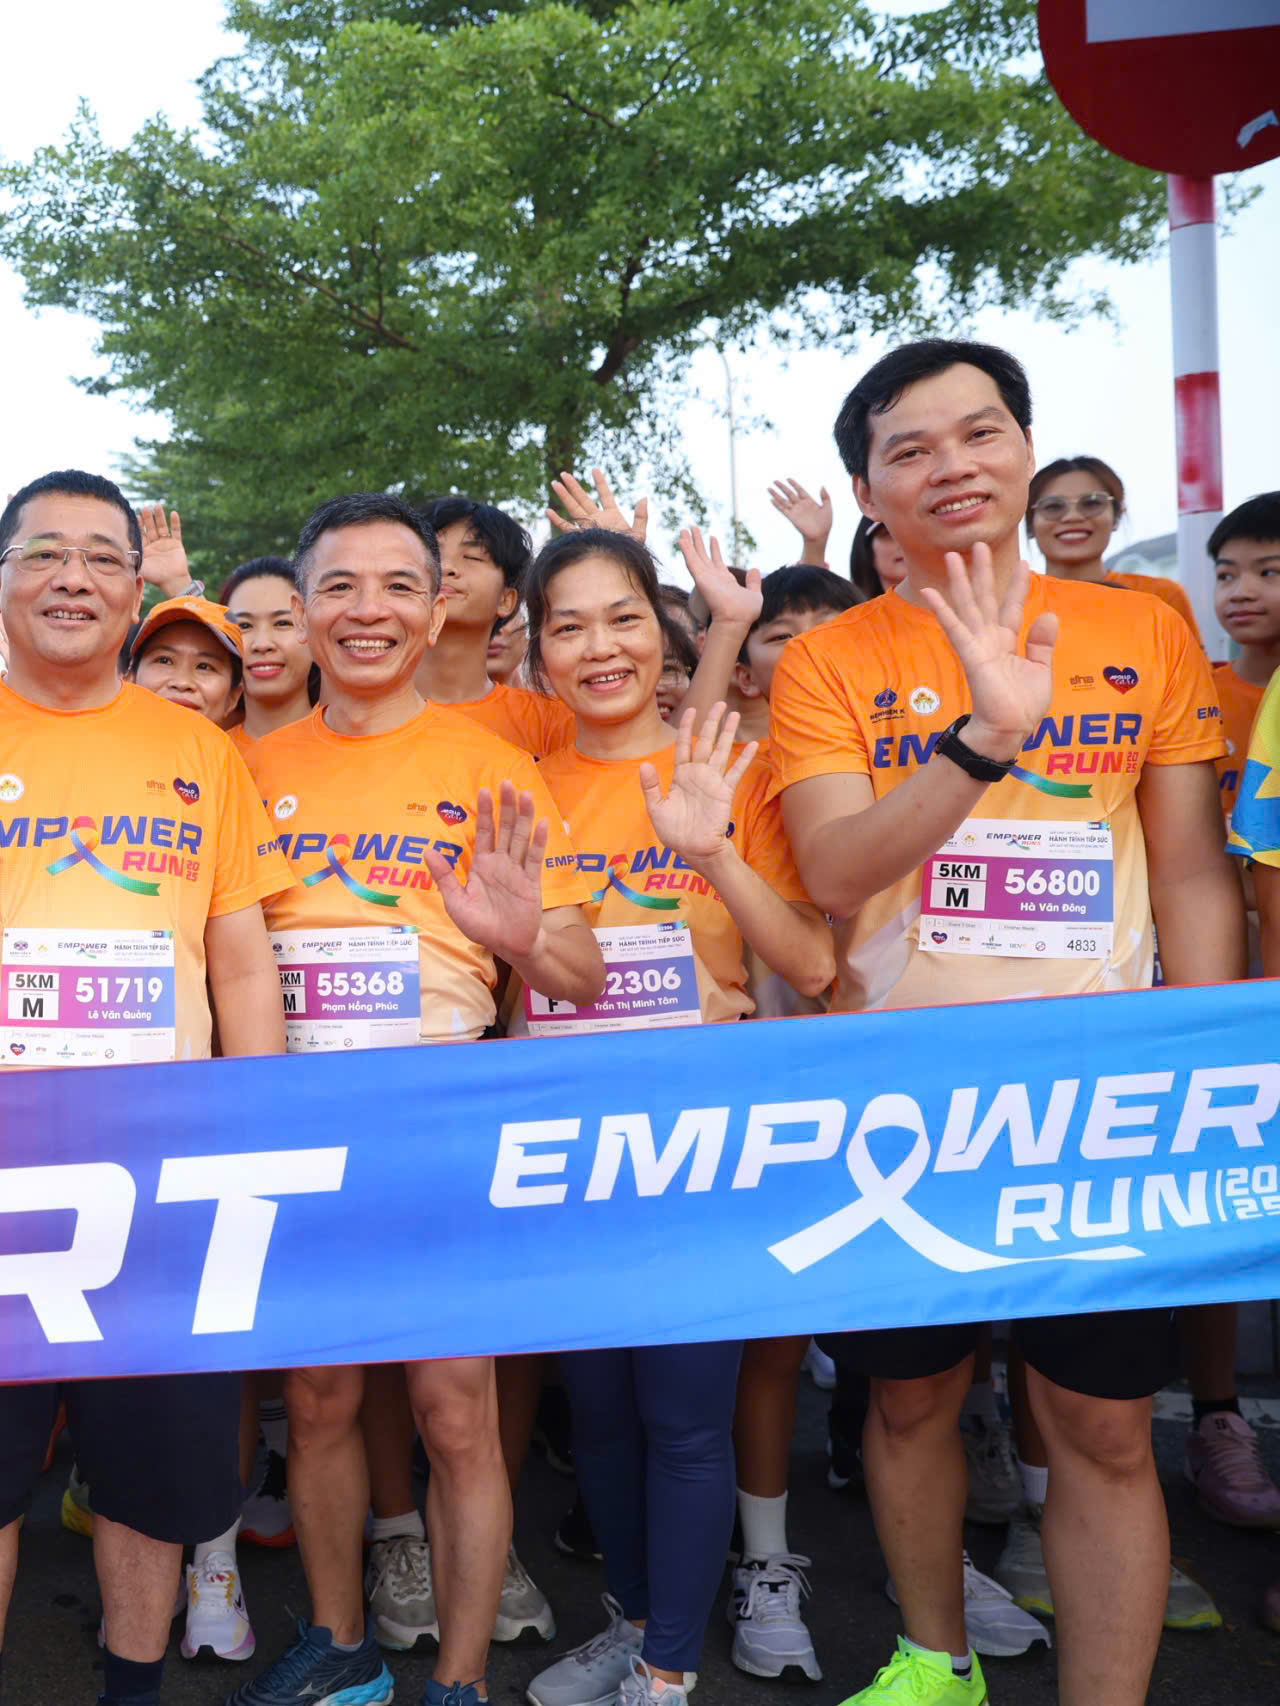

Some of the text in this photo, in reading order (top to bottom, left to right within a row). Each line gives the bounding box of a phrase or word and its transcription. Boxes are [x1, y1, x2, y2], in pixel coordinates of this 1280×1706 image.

[873, 713, 1142, 768] EMWER
[1046, 752, 1122, 775] RUN
[986, 832, 1042, 841] EMPOWER
[122, 851, 184, 877] RUN
[938, 863, 981, 879] 5KM
[366, 865, 433, 890] RUN
[644, 873, 710, 896] RUN
[1004, 868, 1100, 896] 56800
[945, 887, 969, 908] M
[1020, 902, 1036, 912] Hà
[1039, 902, 1059, 913] Văn
[58, 942, 107, 950] EMPOWER
[302, 941, 342, 949] EMPOWER
[1067, 940, 1096, 952] 4833
[15, 973, 54, 989] 5KM
[75, 977, 163, 1003] 51719
[317, 971, 404, 996] 55368
[601, 967, 682, 996] 2306
[22, 997, 44, 1018] M
[283, 993, 296, 1011] M
[322, 1003, 346, 1013] Phạm
[375, 1001, 399, 1010] Phúc
[617, 1000, 630, 1011] Thị
[657, 997, 678, 1005] Tâm
[88, 1010, 99, 1020] Lê
[102, 1009, 121, 1020] Văn
[489, 1063, 1280, 1208] EMPOWER
[1226, 1165, 1277, 1196] 20
[995, 1171, 1208, 1246] RUN
